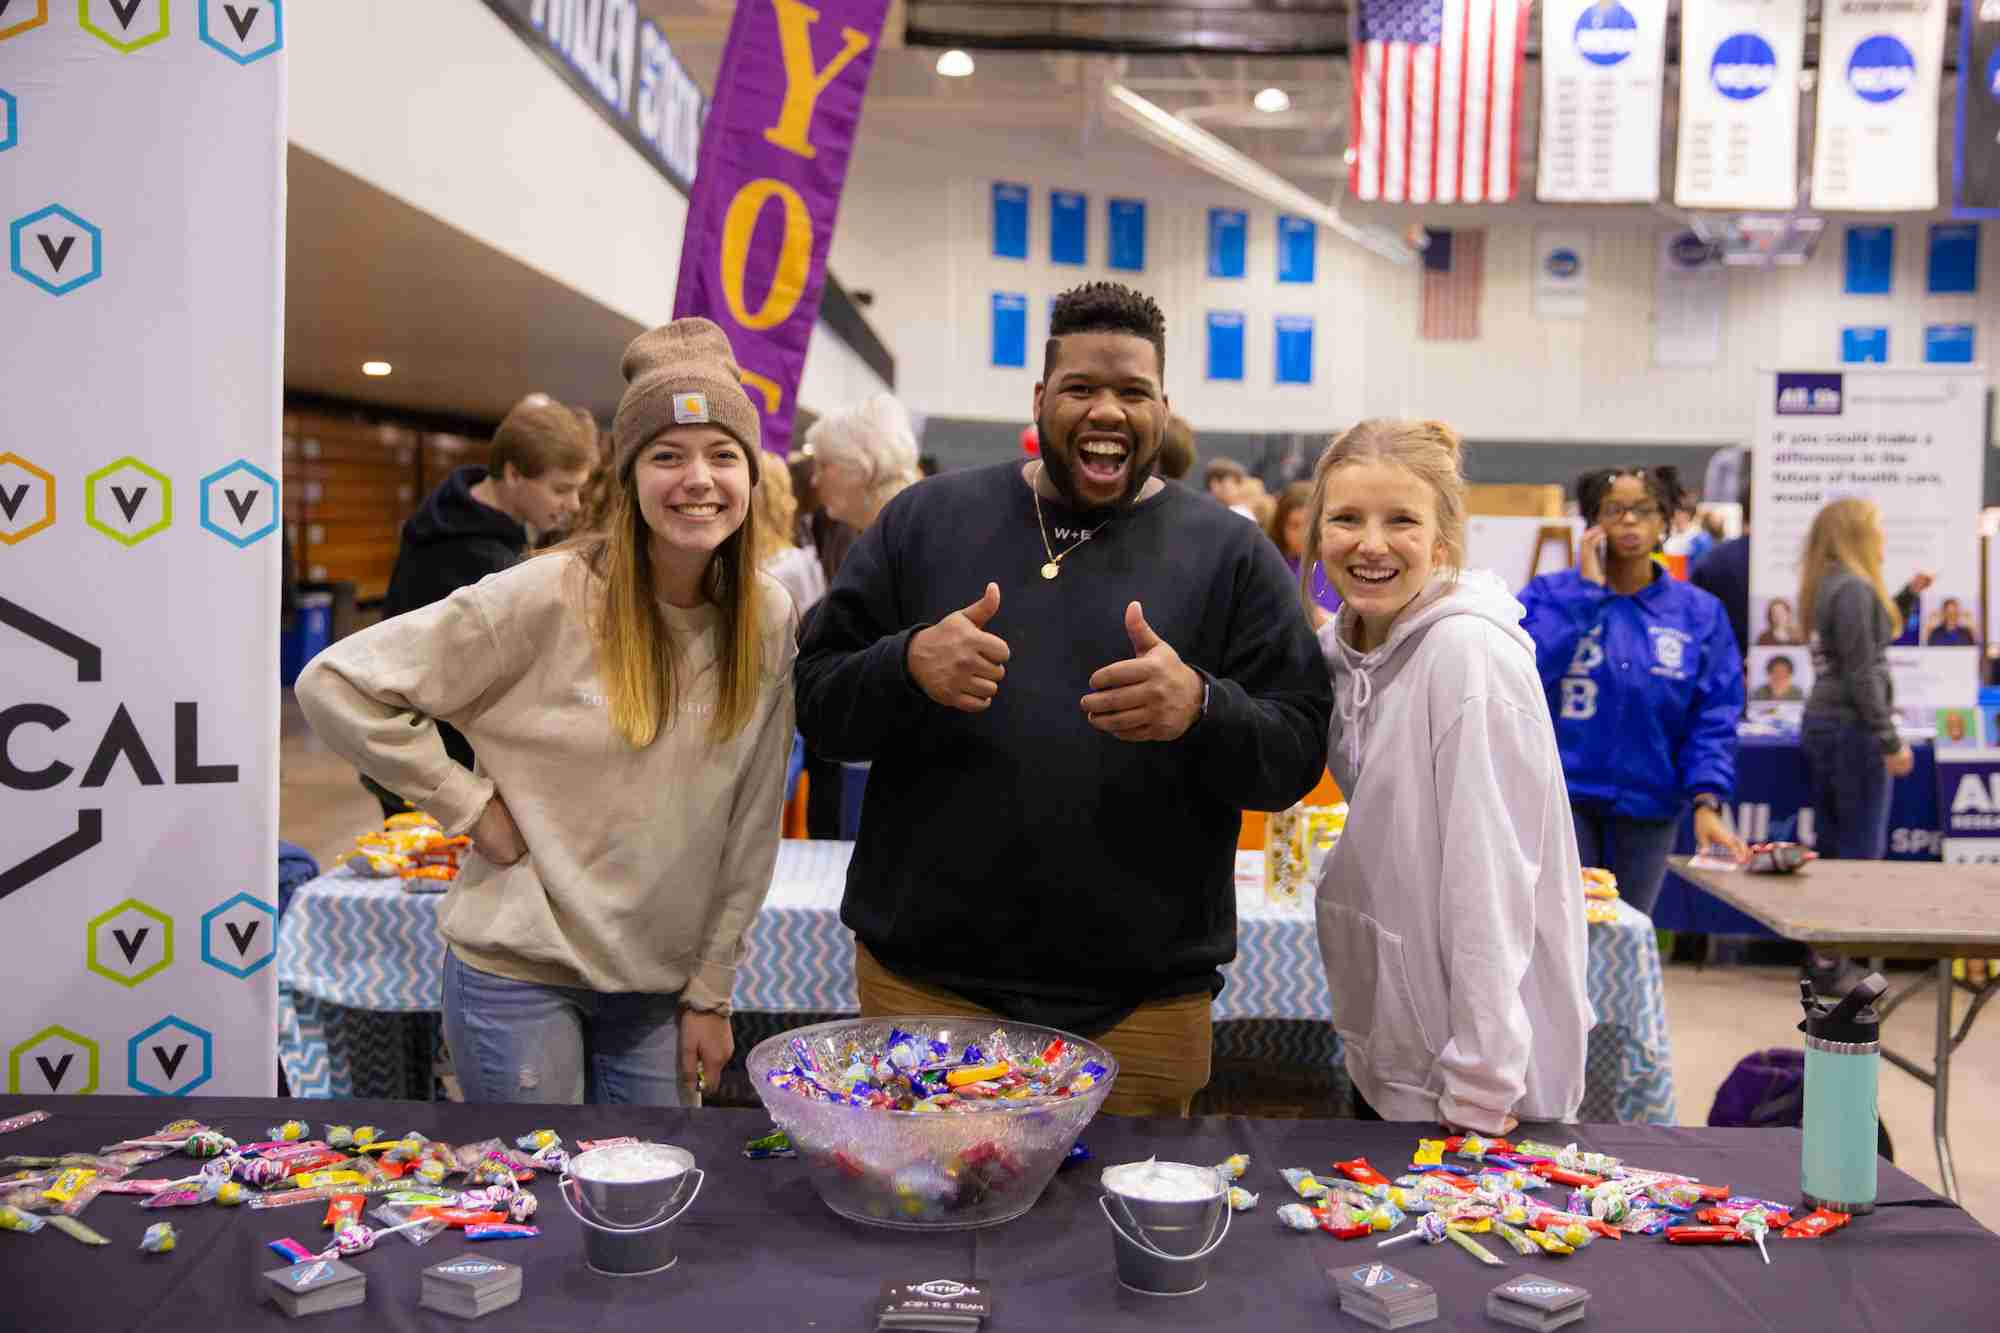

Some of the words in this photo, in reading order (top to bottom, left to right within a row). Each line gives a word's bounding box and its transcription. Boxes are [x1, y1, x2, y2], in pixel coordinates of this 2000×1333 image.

[223, 4, 259, 42] V
[37, 233, 75, 272] V
[111, 487, 147, 524] V
[226, 489, 259, 525] V
[112, 927, 150, 966] V
[224, 919, 260, 957] V
[35, 1053, 75, 1092] V
[152, 1043, 190, 1081] V
